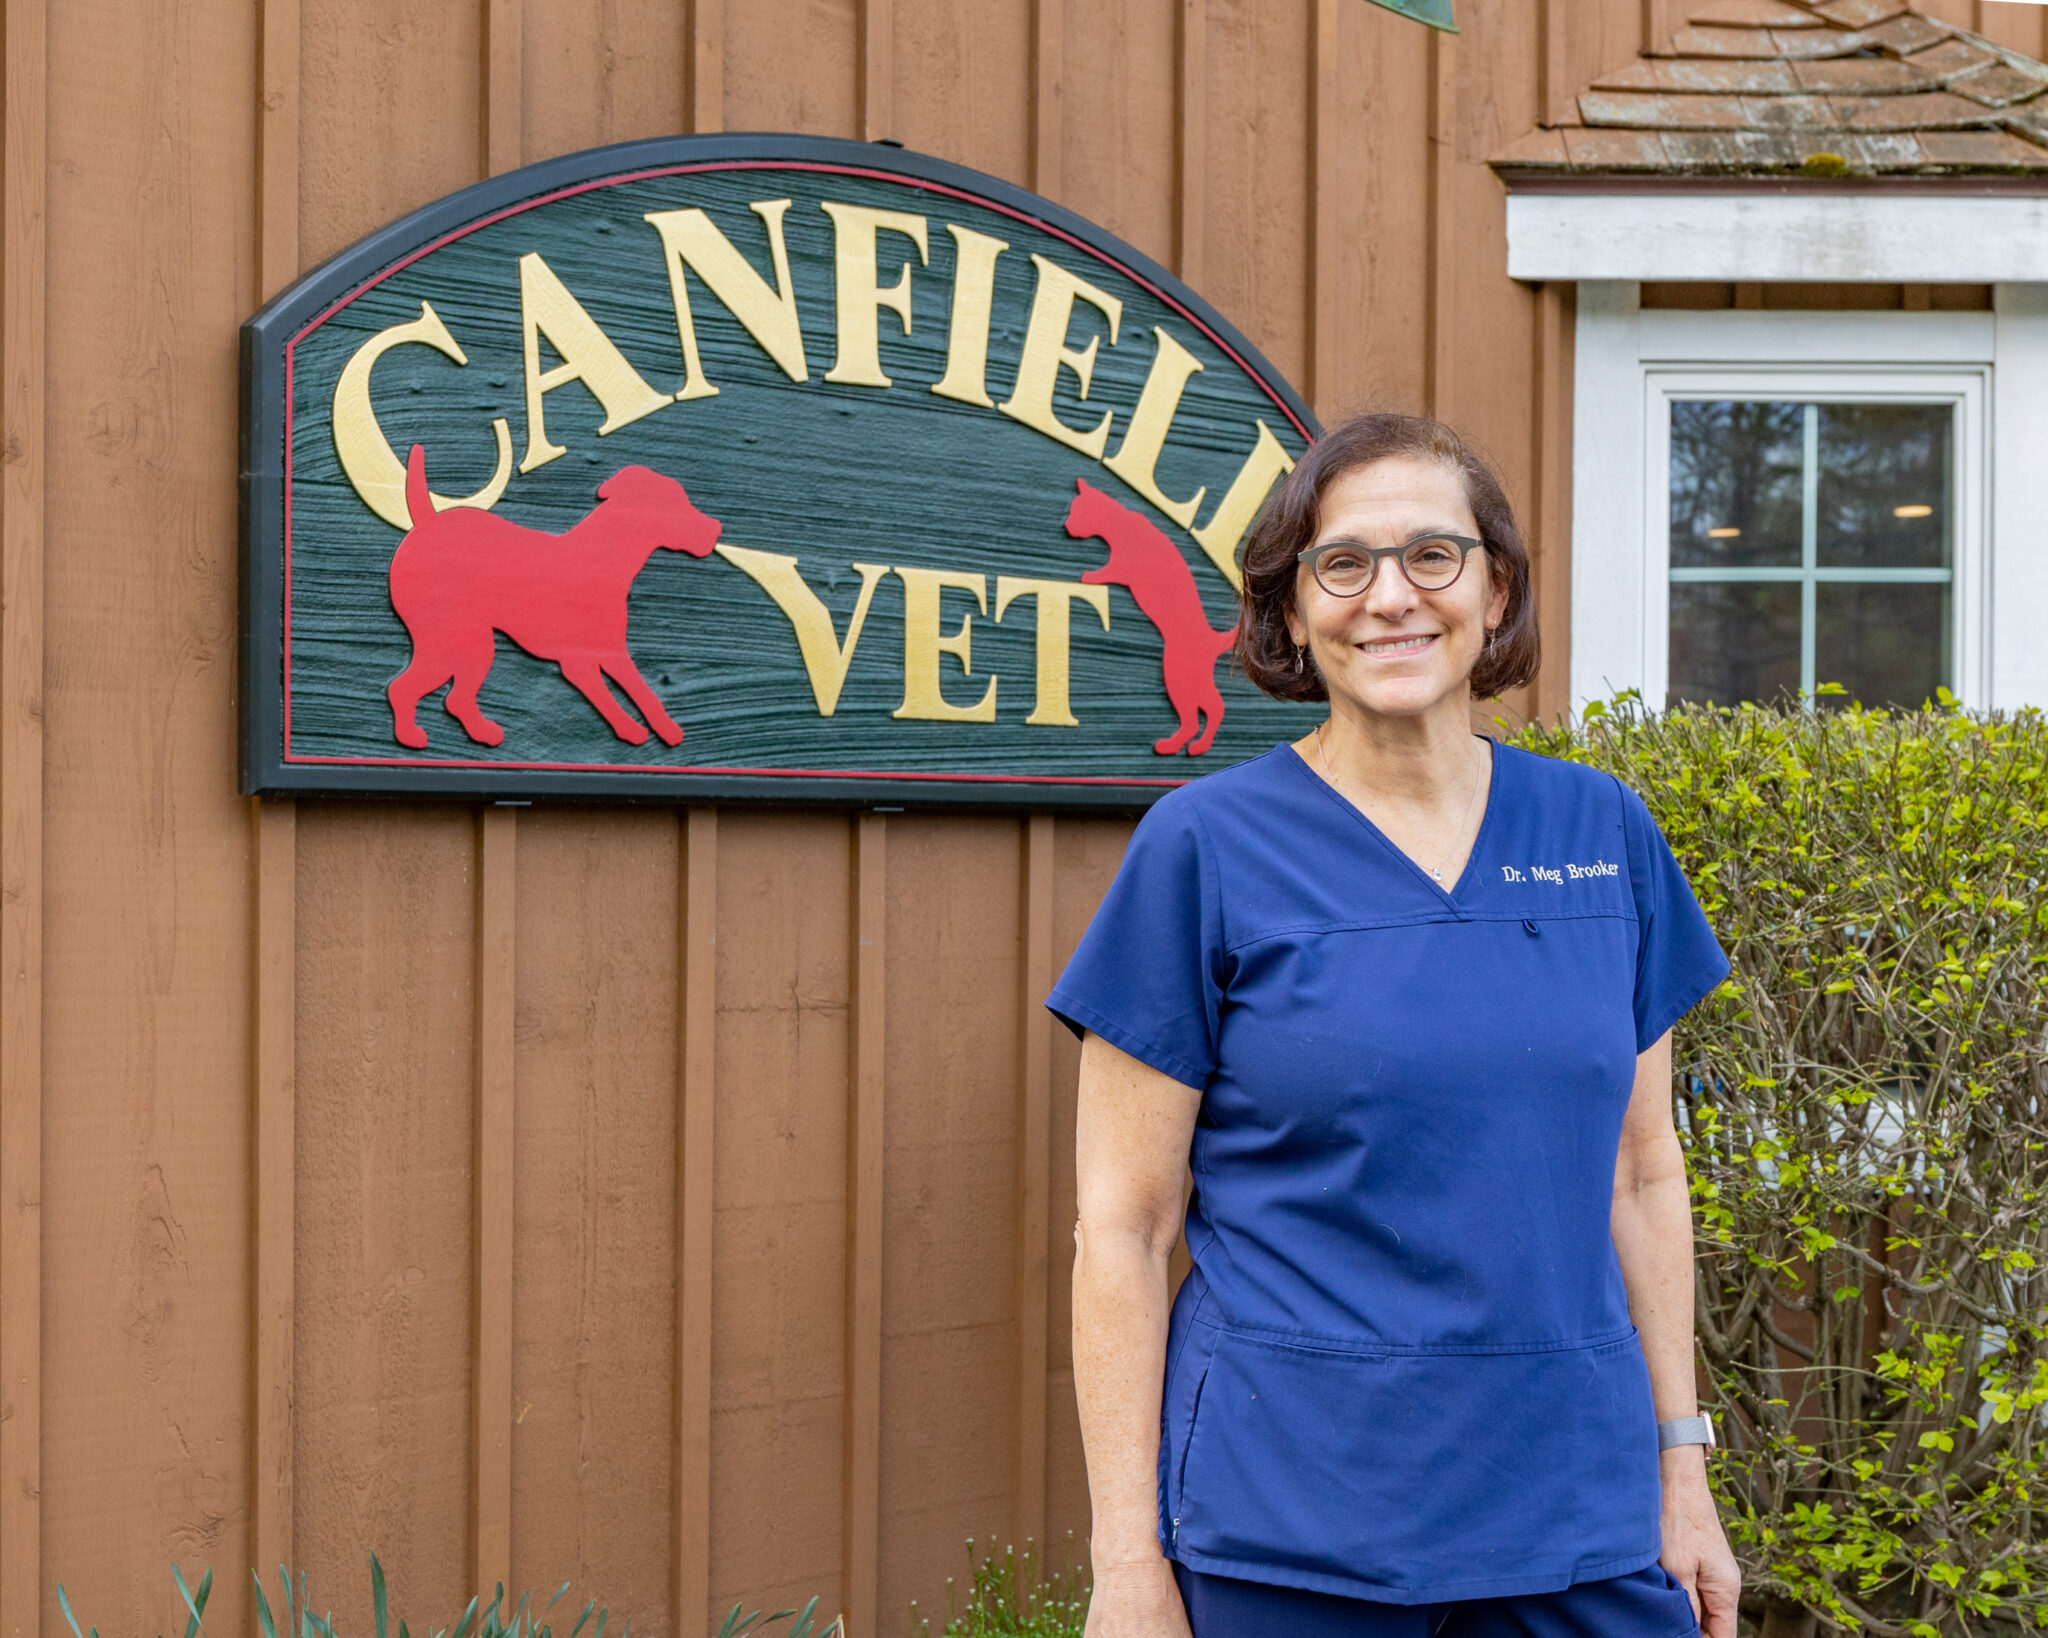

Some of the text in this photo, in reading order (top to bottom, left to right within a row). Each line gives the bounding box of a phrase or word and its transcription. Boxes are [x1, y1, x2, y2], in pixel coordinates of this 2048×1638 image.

[714, 543, 1110, 726] VET
[1501, 859, 1619, 885] Dr. Meg Brooker
